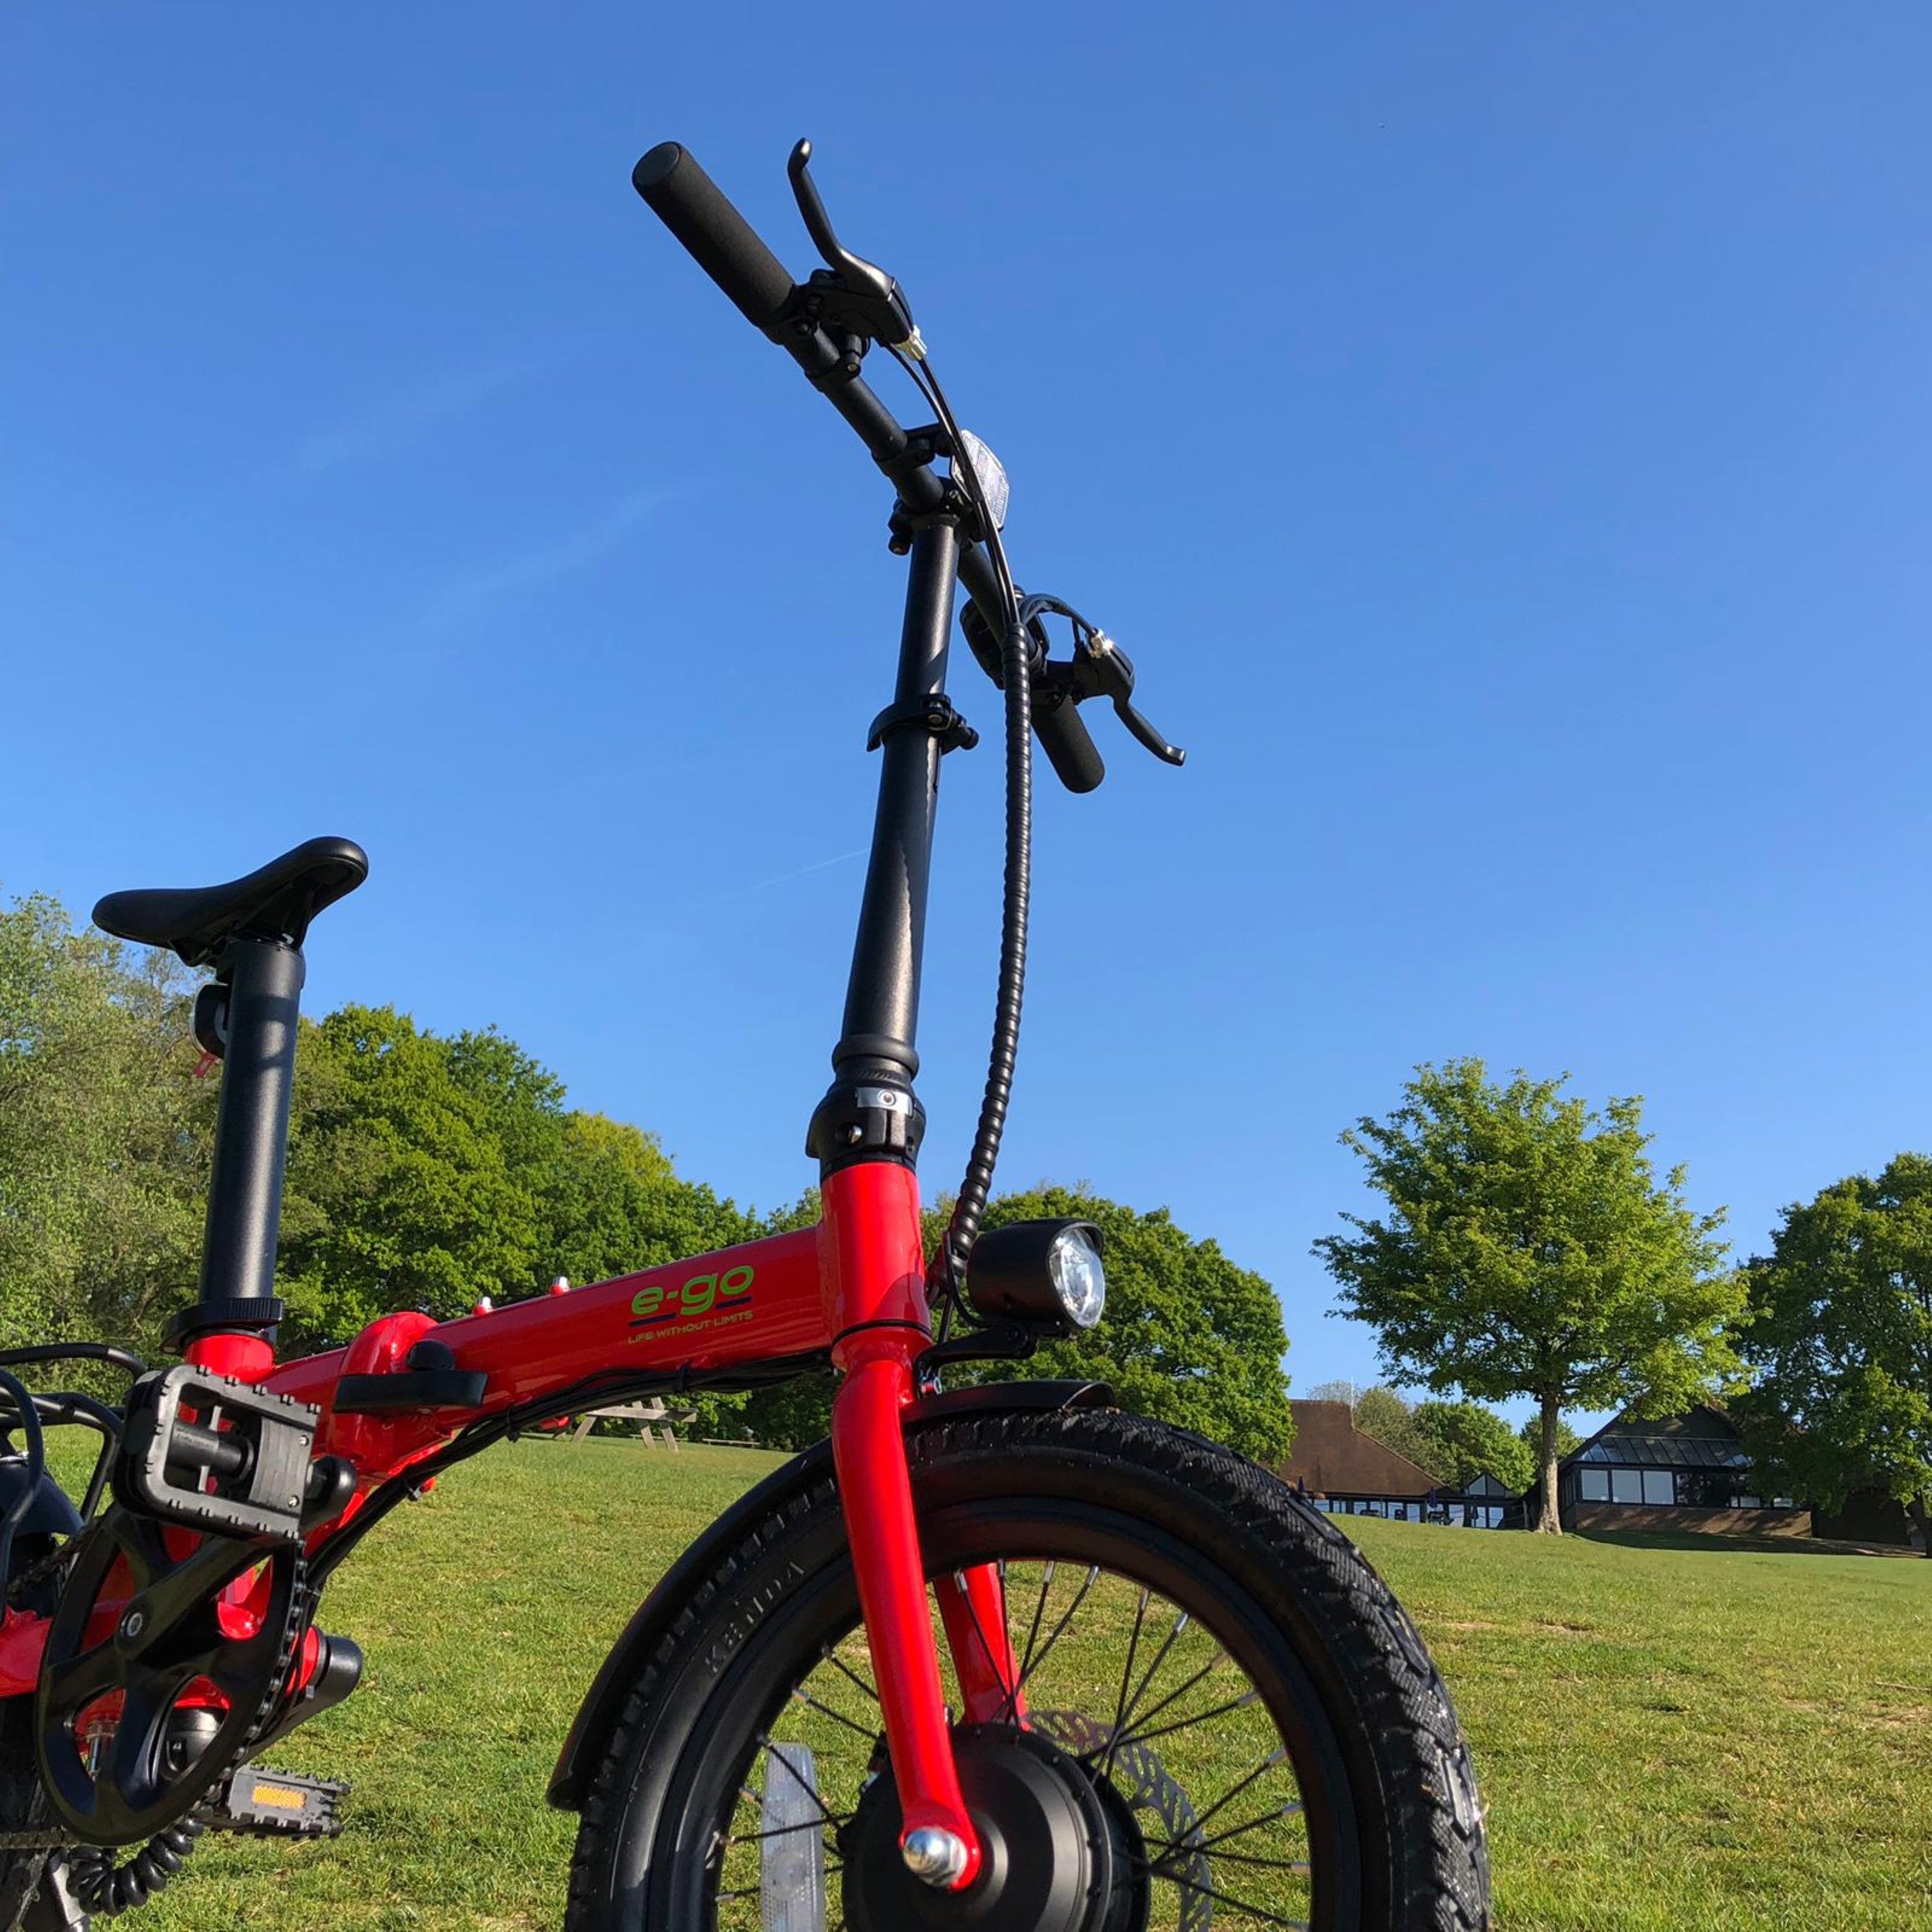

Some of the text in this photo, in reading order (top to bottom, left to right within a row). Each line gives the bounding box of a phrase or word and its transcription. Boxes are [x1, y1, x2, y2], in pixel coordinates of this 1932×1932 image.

[631, 1265, 754, 1315] e-go
[628, 1311, 753, 1344] LIFE WITHOUT LIMITS
